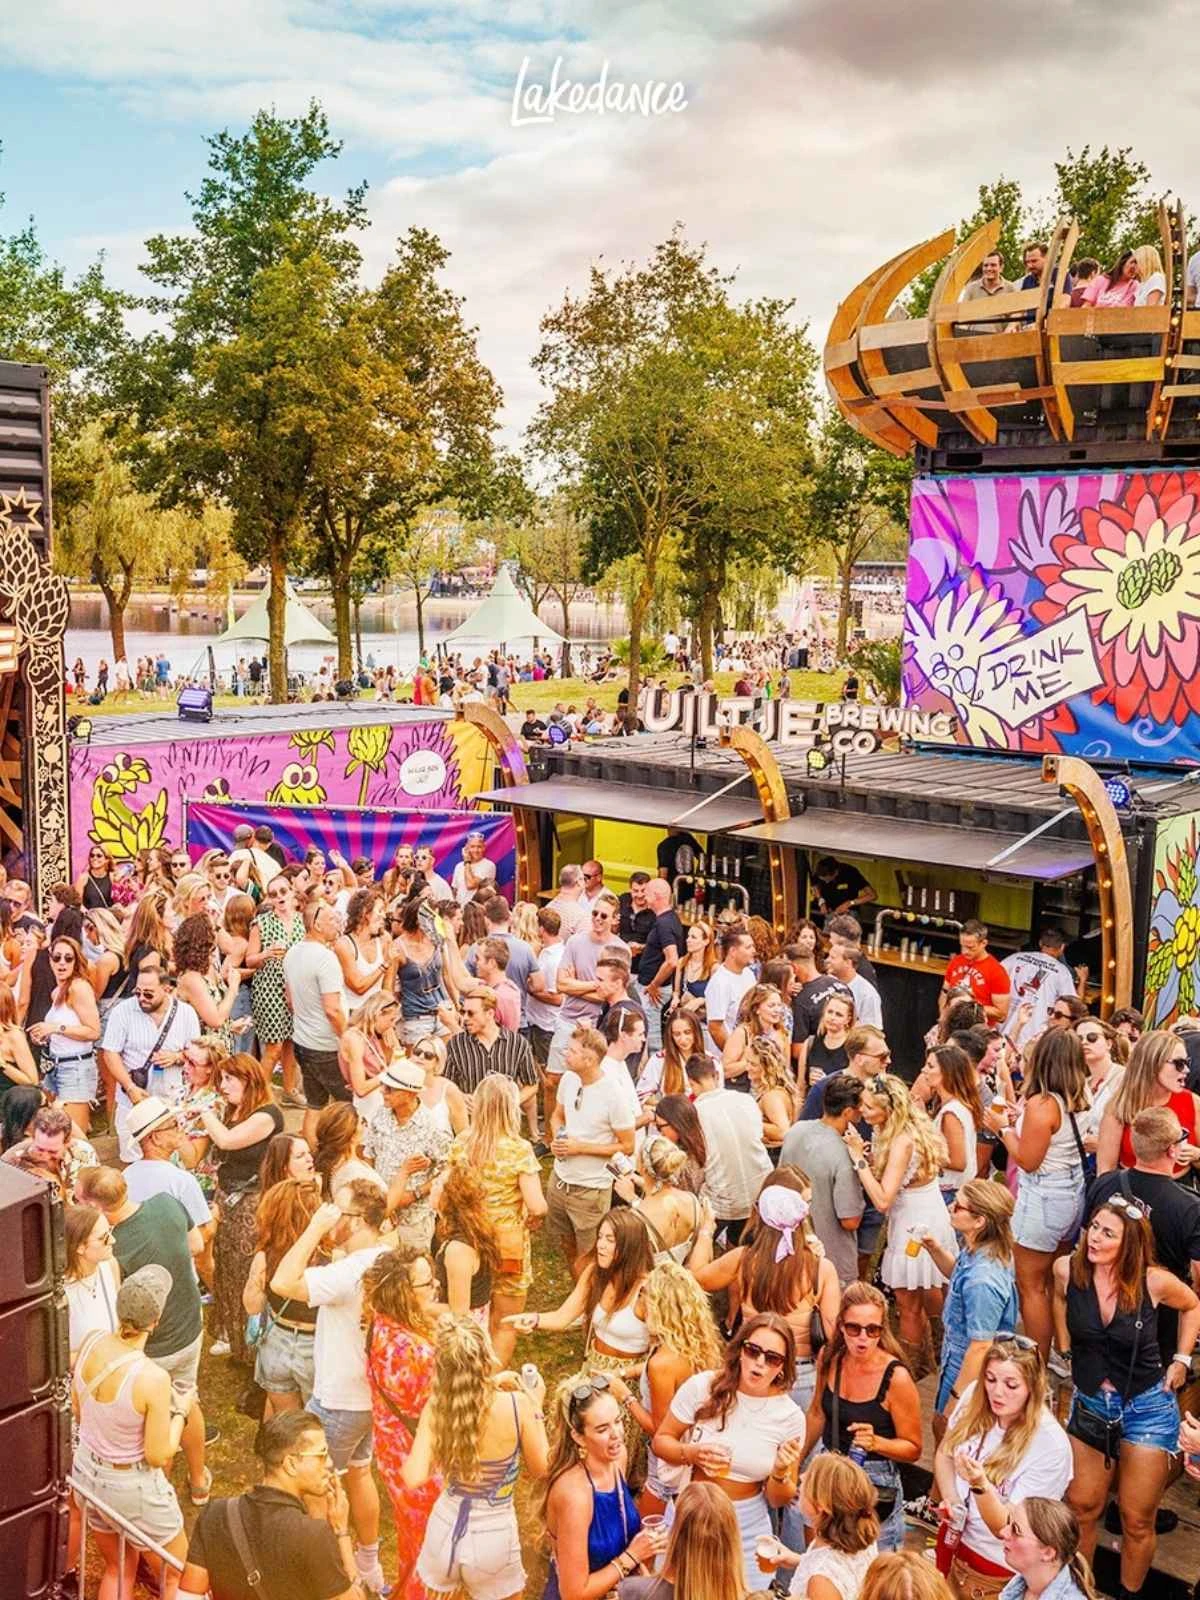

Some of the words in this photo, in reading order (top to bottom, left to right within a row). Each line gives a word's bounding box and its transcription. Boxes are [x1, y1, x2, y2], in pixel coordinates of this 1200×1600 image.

[987, 632, 1084, 690] DRINK
[643, 689, 824, 746] UILTJE
[827, 702, 957, 737] BREWING
[1012, 670, 1073, 710] ME
